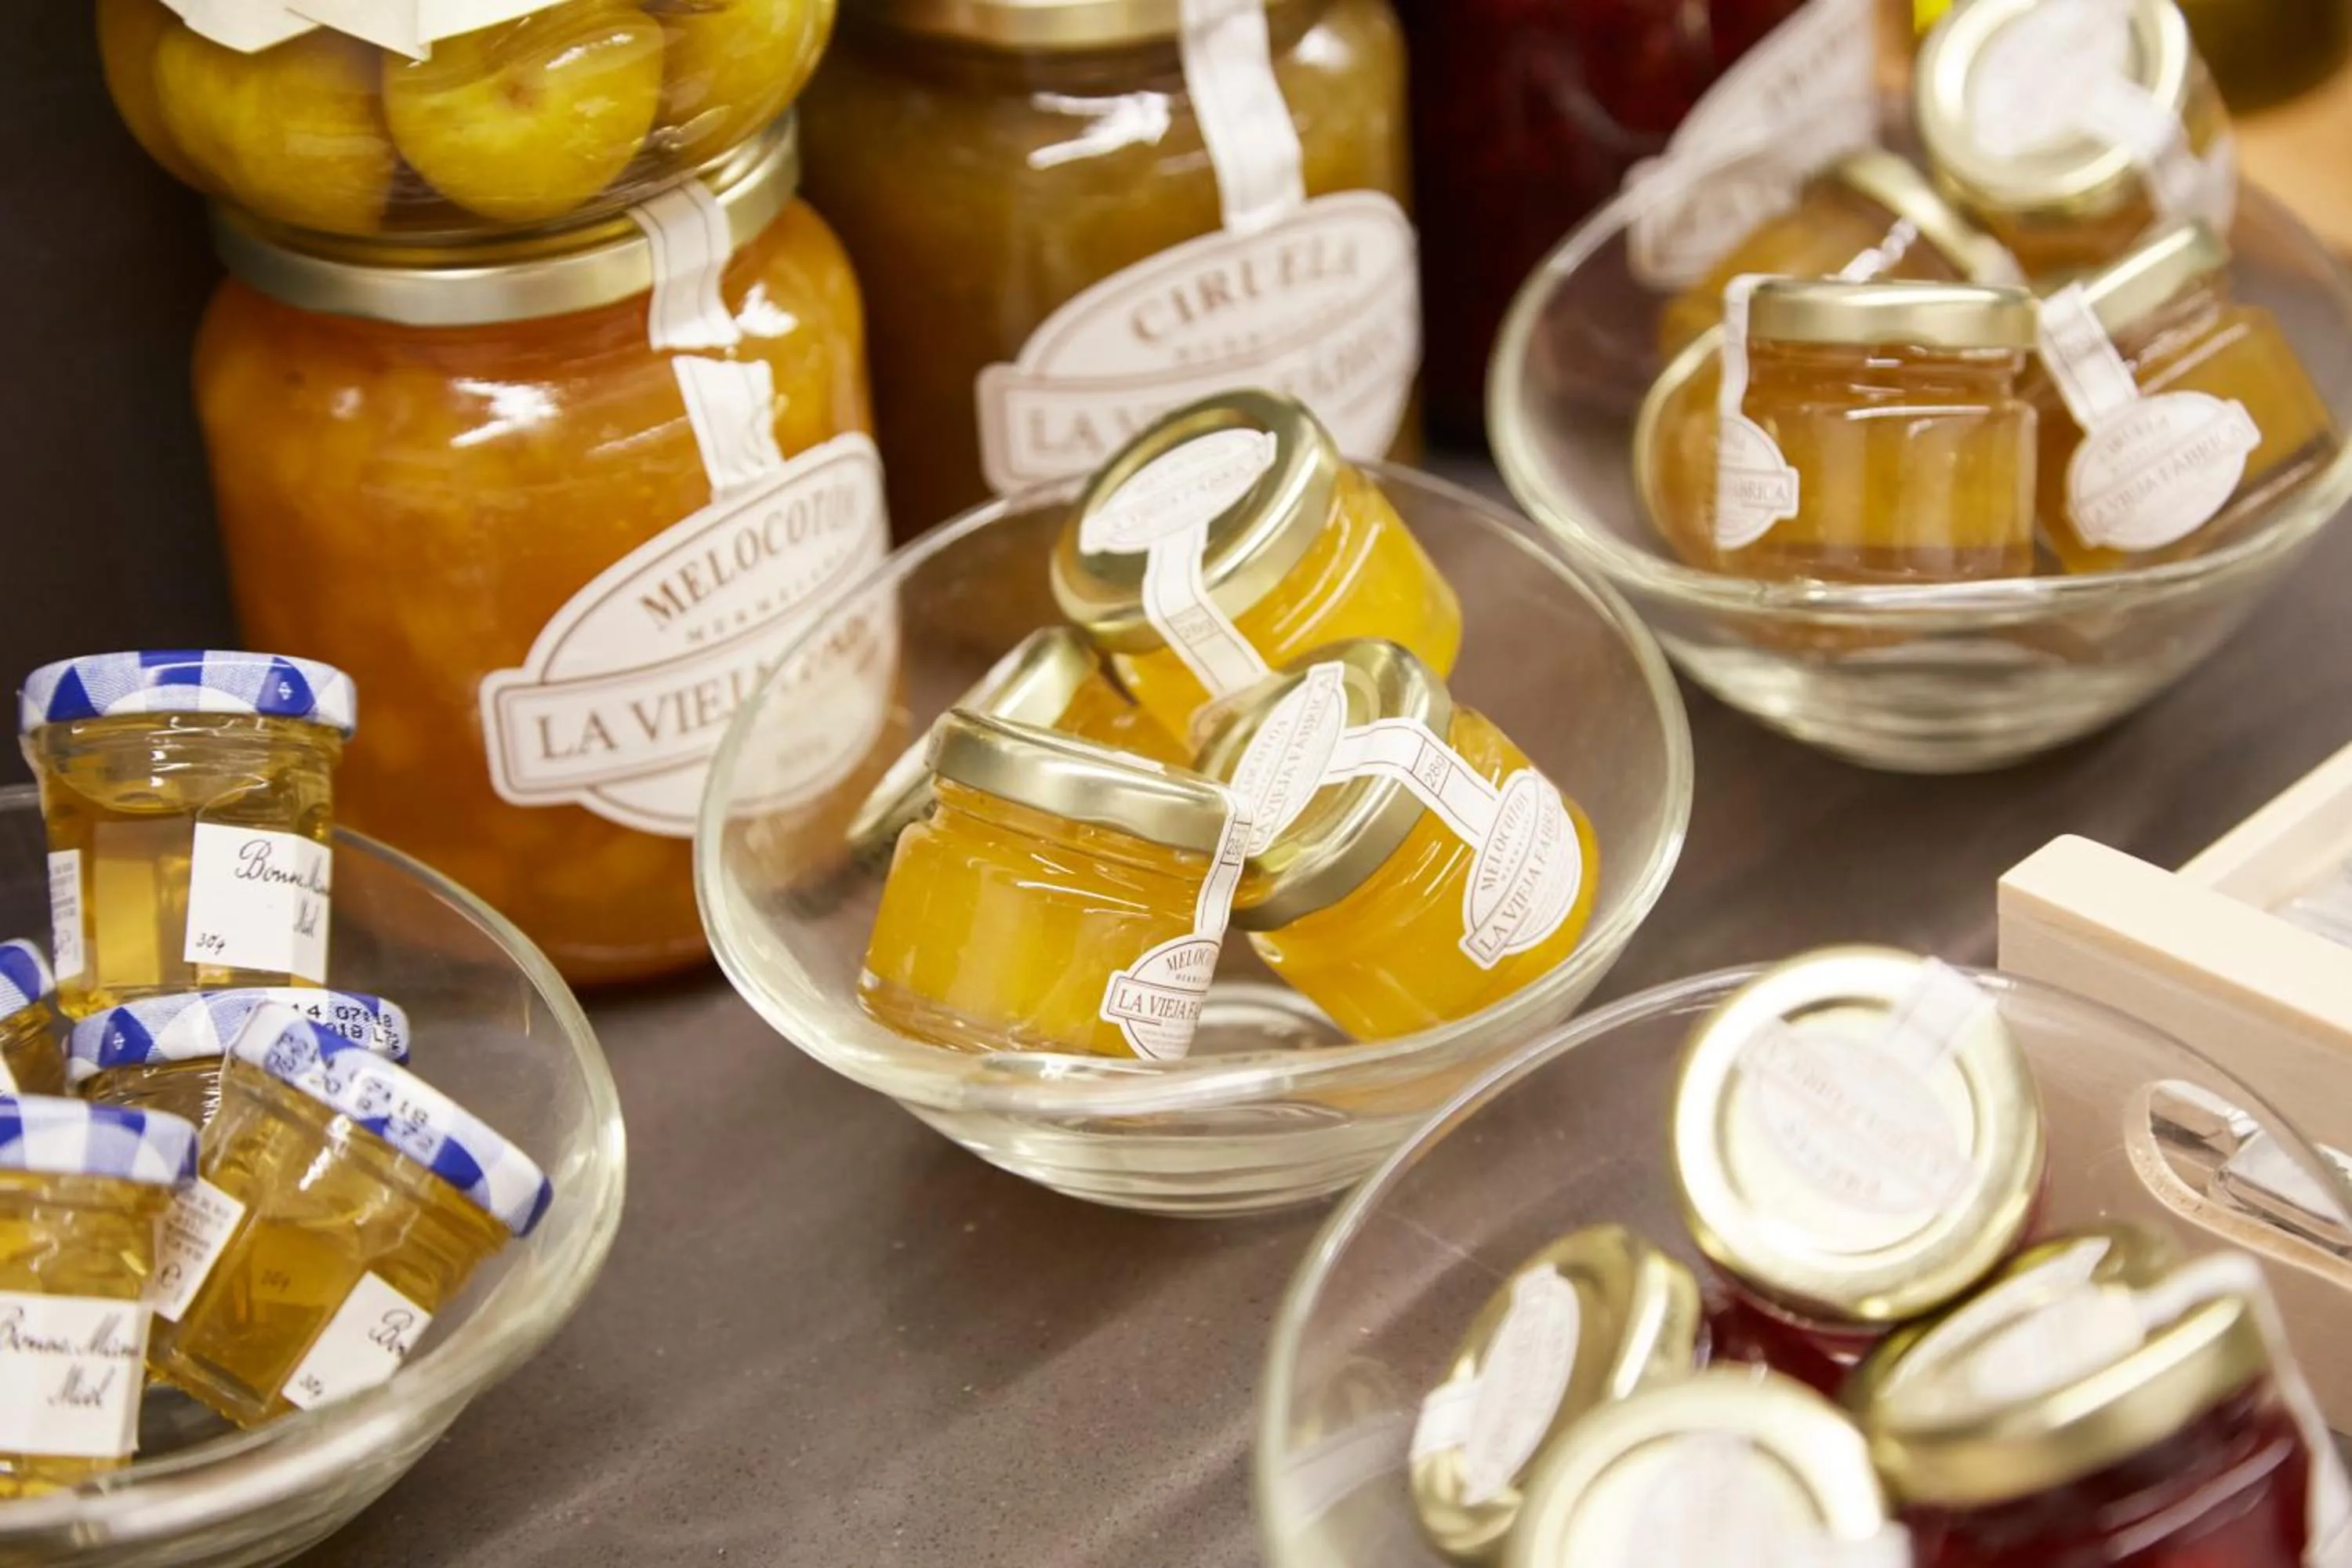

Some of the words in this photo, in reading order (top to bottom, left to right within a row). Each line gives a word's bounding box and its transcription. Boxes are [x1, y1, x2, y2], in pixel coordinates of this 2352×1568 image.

[535, 710, 617, 761] LA
[1479, 924, 1511, 951] LA
[1508, 866, 1544, 921] VIEJA
[1118, 988, 1143, 1014] LA
[1149, 994, 1187, 1020] VIEJA
